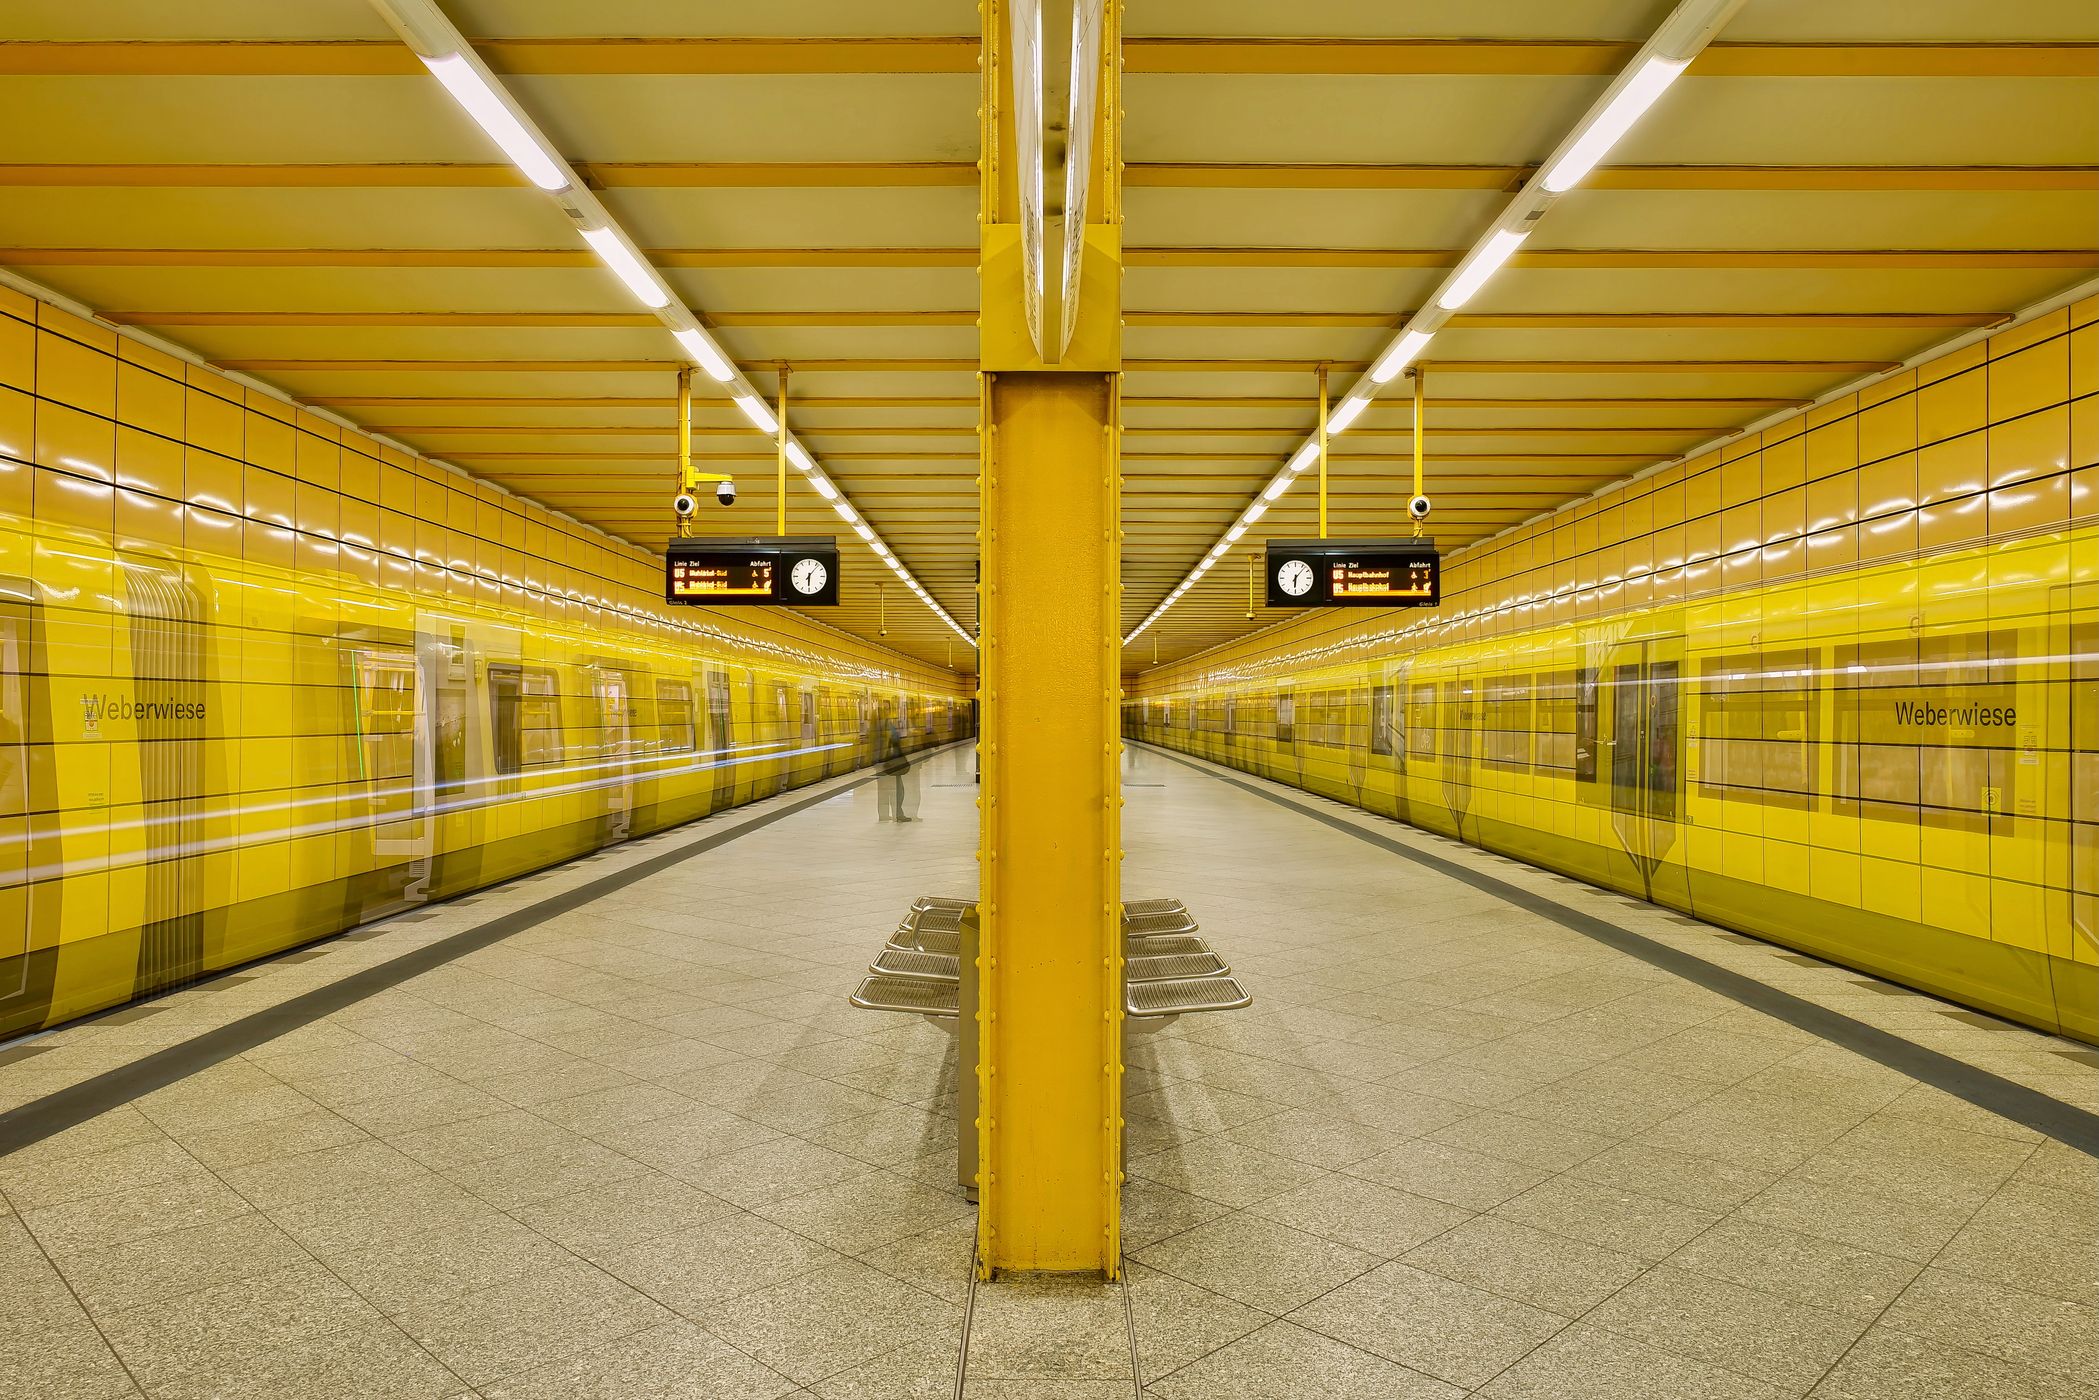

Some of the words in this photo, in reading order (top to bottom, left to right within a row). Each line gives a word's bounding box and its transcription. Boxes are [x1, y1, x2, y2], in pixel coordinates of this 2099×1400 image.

[674, 568, 685, 578] U5
[1333, 569, 1344, 579] U5
[1348, 571, 1389, 579] Hauptbahnhof
[83, 694, 206, 720] Weberwiese
[1895, 701, 2017, 726] Weberwiese
